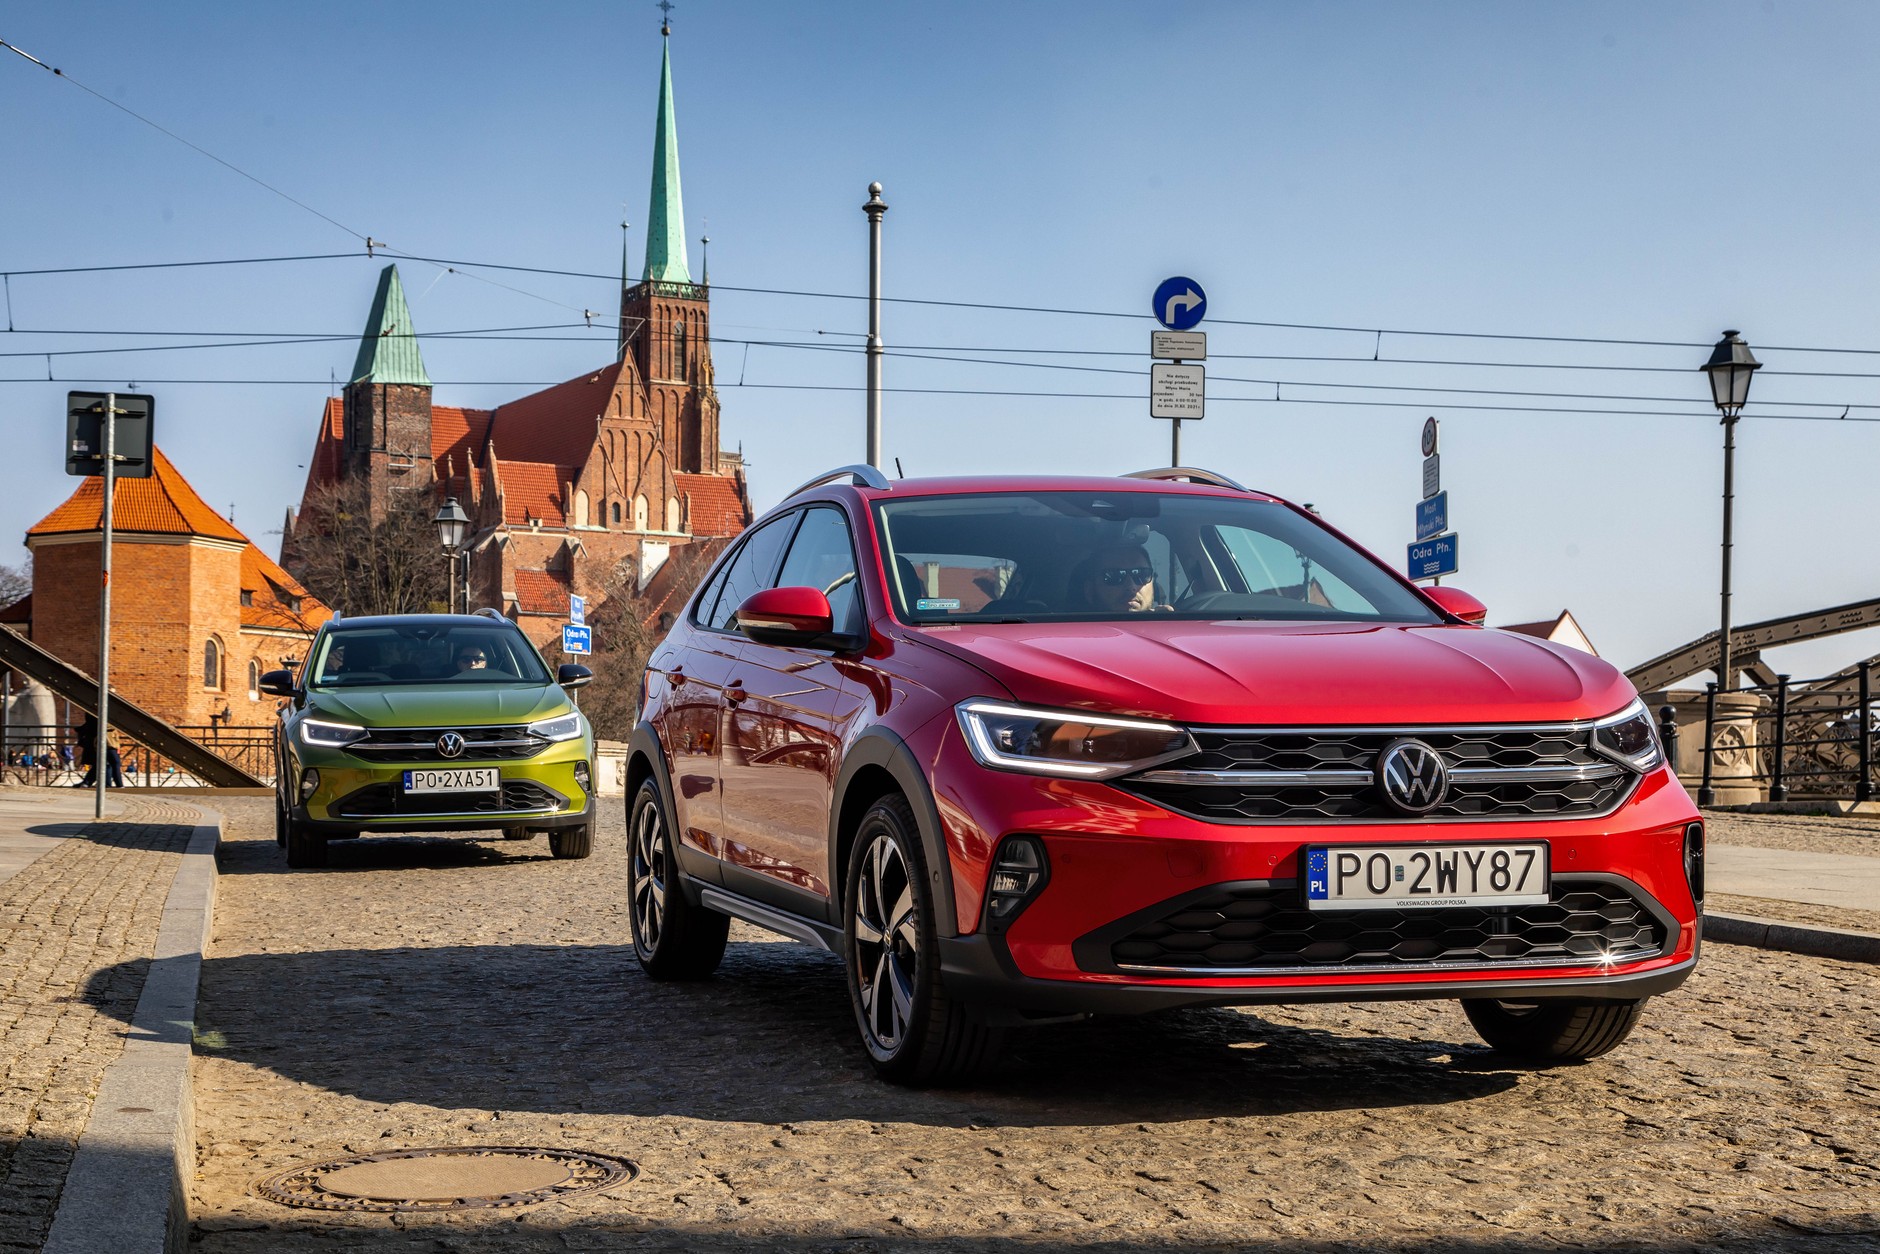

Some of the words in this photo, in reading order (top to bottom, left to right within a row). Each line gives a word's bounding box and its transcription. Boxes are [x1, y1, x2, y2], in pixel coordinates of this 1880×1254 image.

[1424, 503, 1437, 516] Most
[1412, 547, 1432, 560] Odra
[566, 628, 578, 638] Odra
[415, 772, 436, 788] PO
[443, 771, 492, 788] 2XA51
[1336, 852, 1391, 896] PO
[1409, 849, 1536, 894] 2WY87
[1311, 880, 1326, 892] PL
